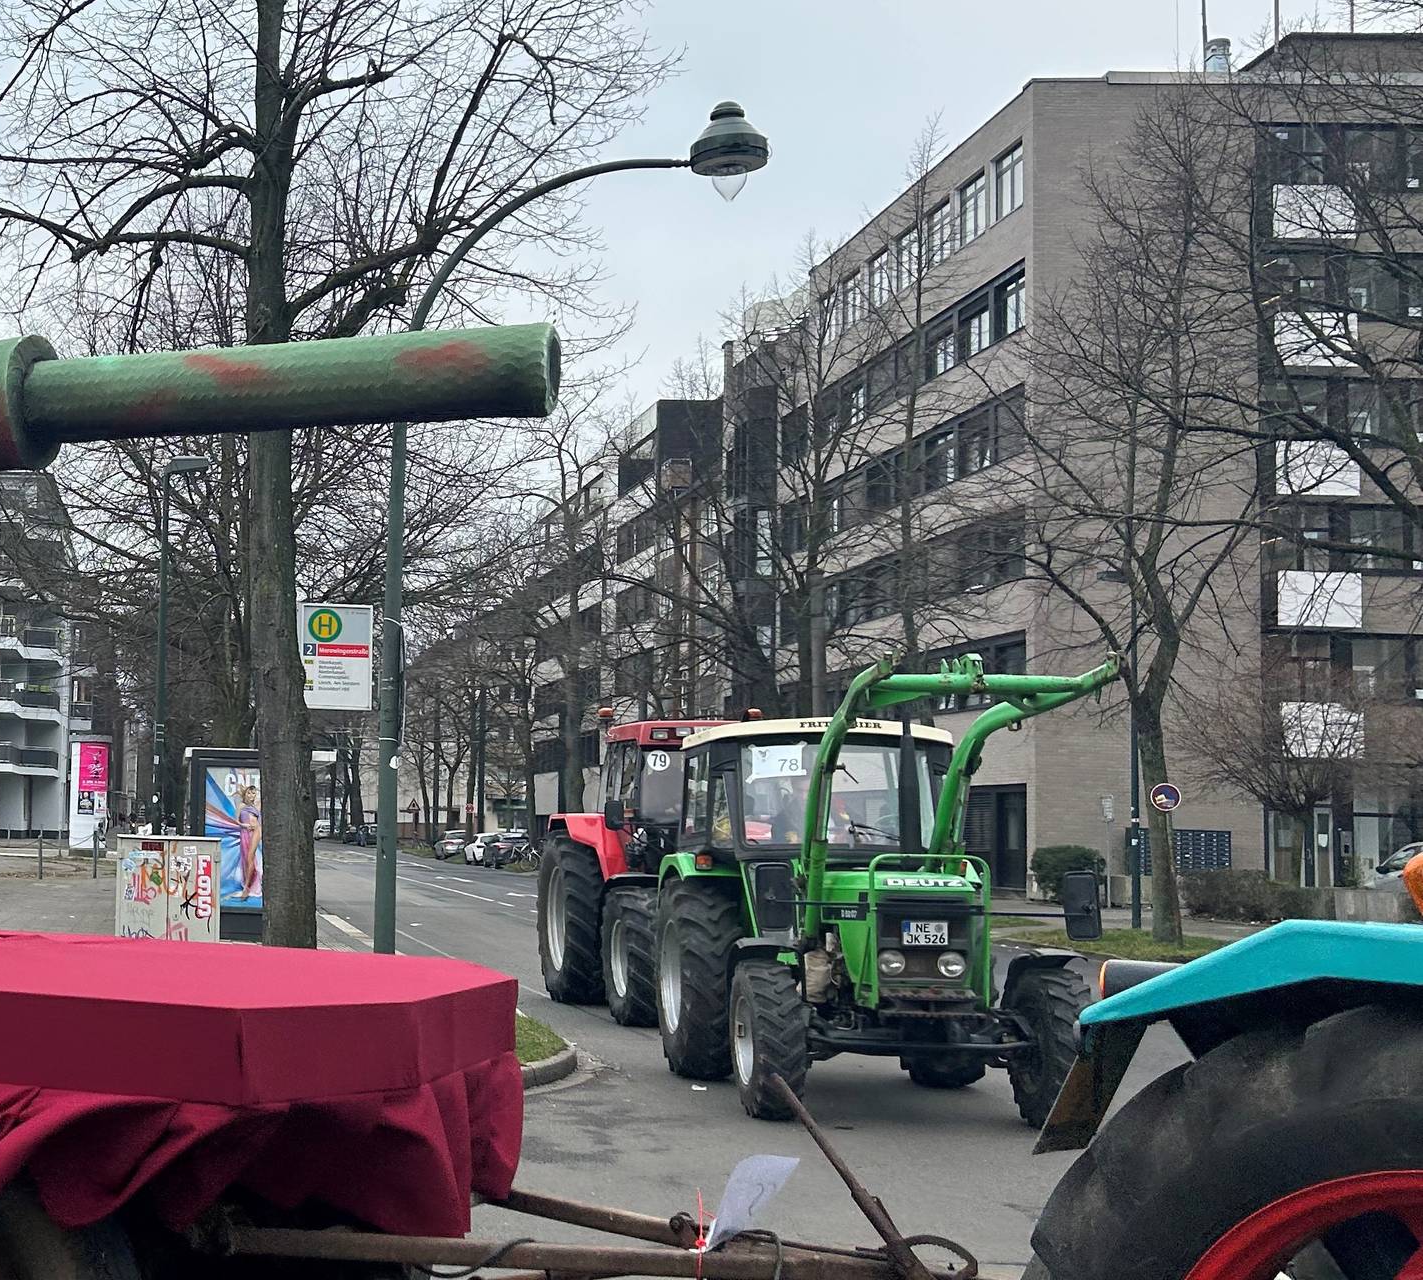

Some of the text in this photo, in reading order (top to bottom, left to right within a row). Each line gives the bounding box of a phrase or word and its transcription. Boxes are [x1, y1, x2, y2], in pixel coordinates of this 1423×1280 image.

[318, 615, 333, 635] H
[305, 644, 313, 655] 2
[651, 753, 667, 767] 79
[778, 758, 799, 773] 78
[886, 878, 964, 887] DEUTZ
[915, 924, 930, 933] NE
[906, 934, 946, 944] JK 526
